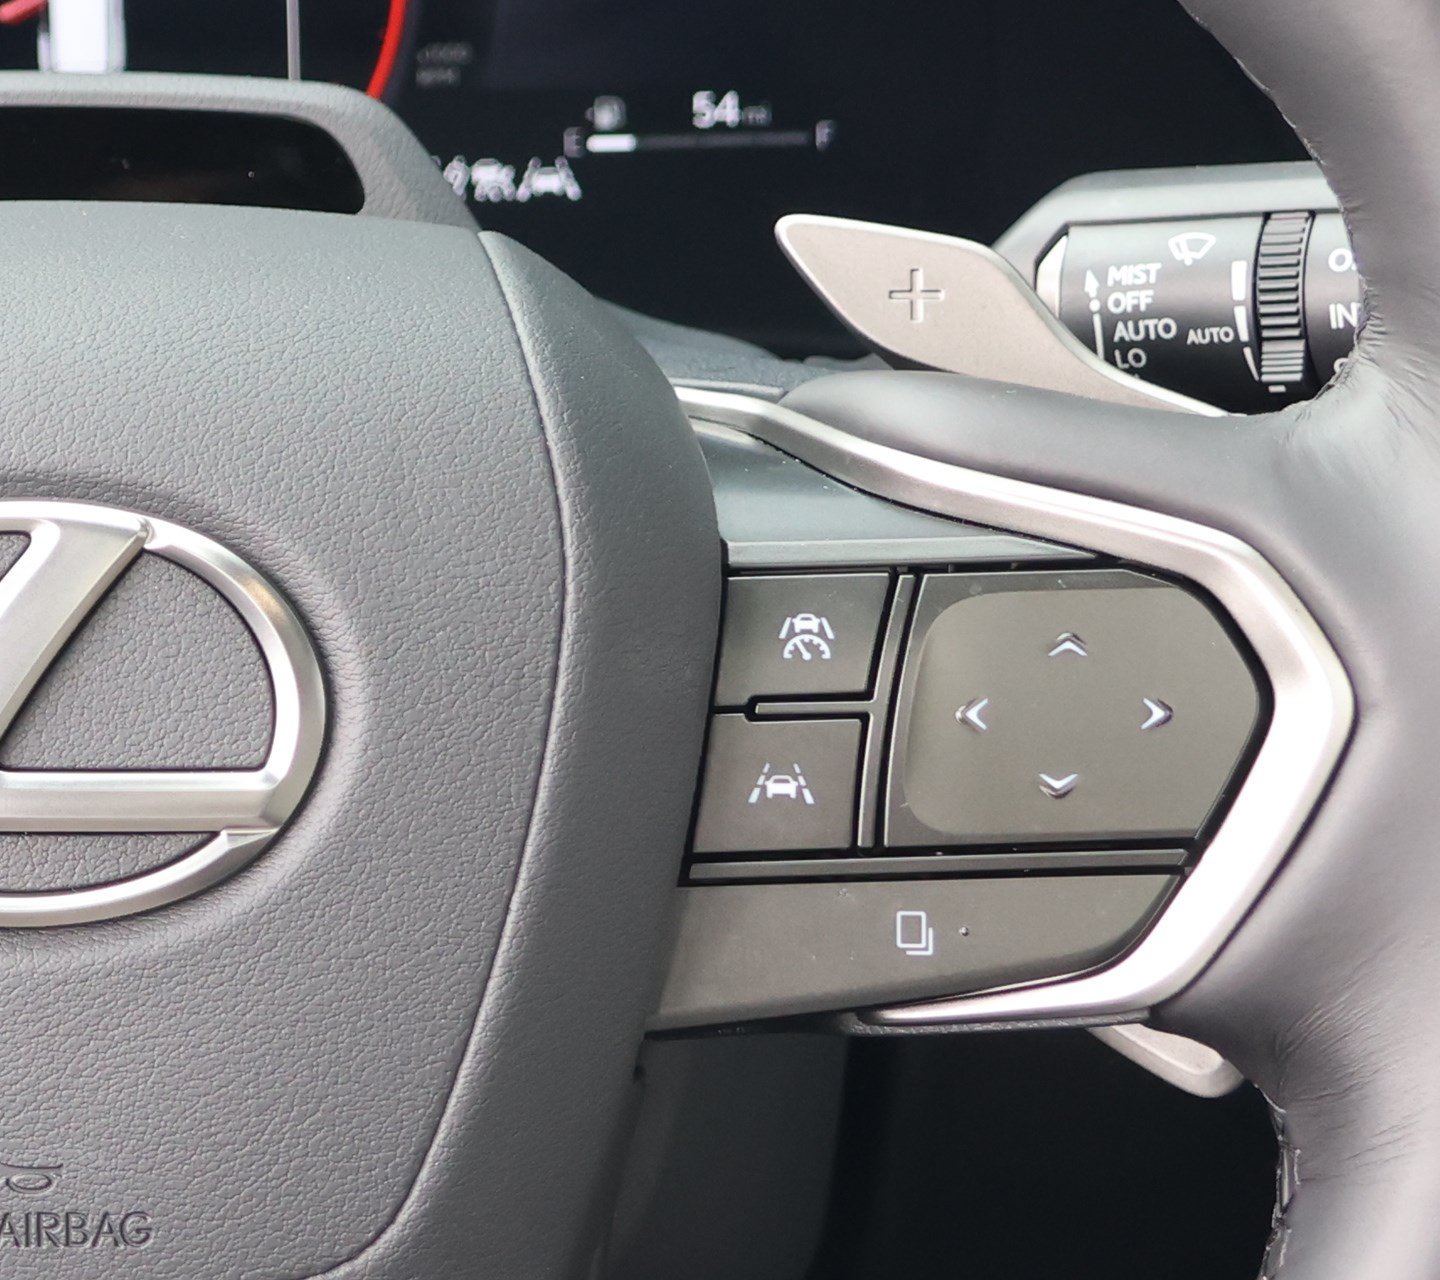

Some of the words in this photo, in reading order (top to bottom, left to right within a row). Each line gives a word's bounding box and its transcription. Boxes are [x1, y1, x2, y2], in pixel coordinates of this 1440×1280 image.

[692, 90, 740, 130] 54
[1107, 261, 1163, 288] MIST
[1106, 289, 1155, 315] OFF
[1113, 317, 1178, 344] AUTO
[1186, 325, 1235, 346] AUTO
[1114, 346, 1147, 370] LO
